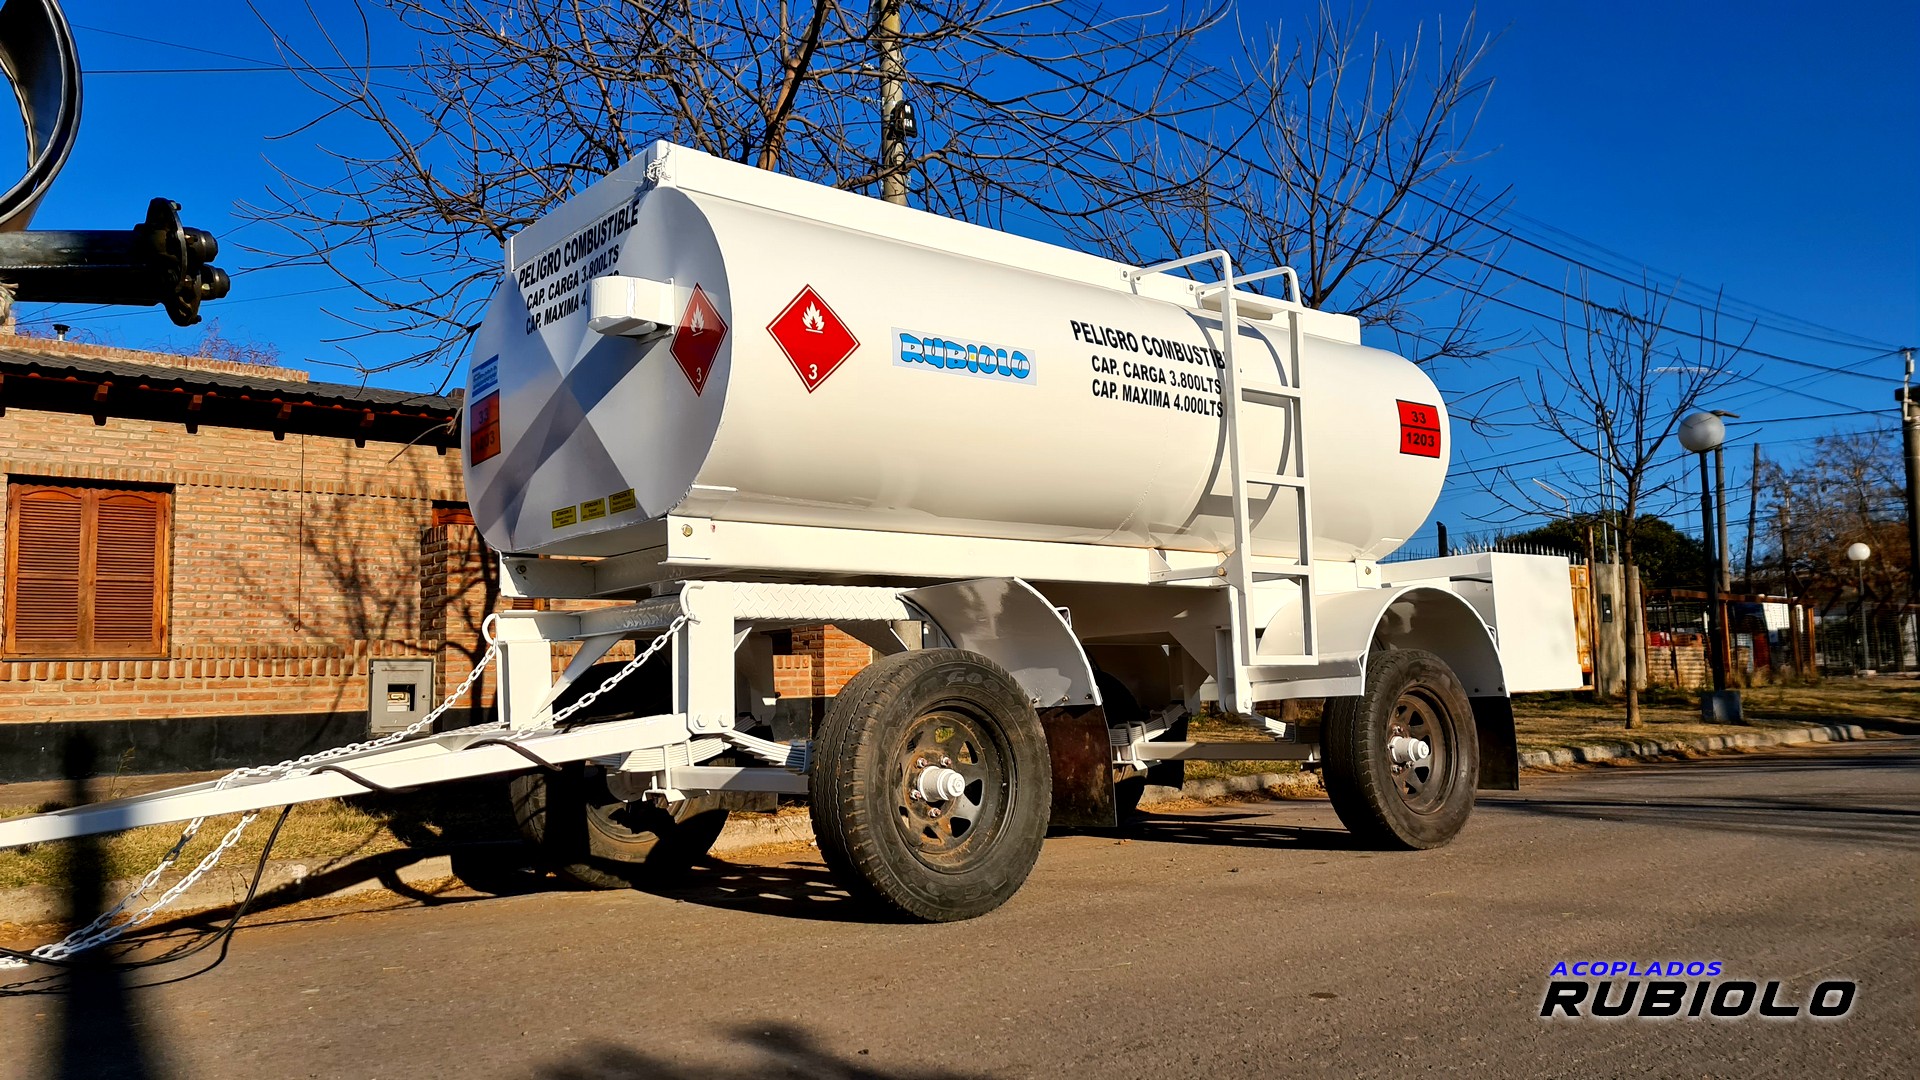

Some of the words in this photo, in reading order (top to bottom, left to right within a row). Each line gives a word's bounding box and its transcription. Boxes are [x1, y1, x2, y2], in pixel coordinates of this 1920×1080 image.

[518, 248, 561, 292] PELIGRO
[564, 198, 640, 267] COMBUSTIBLE
[526, 288, 545, 311] CAP.
[548, 270, 579, 301] CARGA
[581, 244, 620, 284] 3.800LTS
[526, 312, 541, 335] CAP.
[544, 293, 579, 326] MAXIMA
[899, 333, 1031, 379] RUBIOLO
[1070, 320, 1139, 353] PELIGRO
[696, 366, 702, 384] 3
[808, 363, 818, 380] 3
[1091, 355, 1120, 376] CAP.
[1123, 361, 1167, 385] CARGA
[1169, 370, 1222, 395] 3.800LTS
[1092, 379, 1118, 400] CAP.
[1122, 384, 1171, 409] MAXIMA
[1173, 394, 1224, 418] 4.000LTS
[1411, 411, 1427, 425] 33
[1406, 432, 1435, 447] 1203
